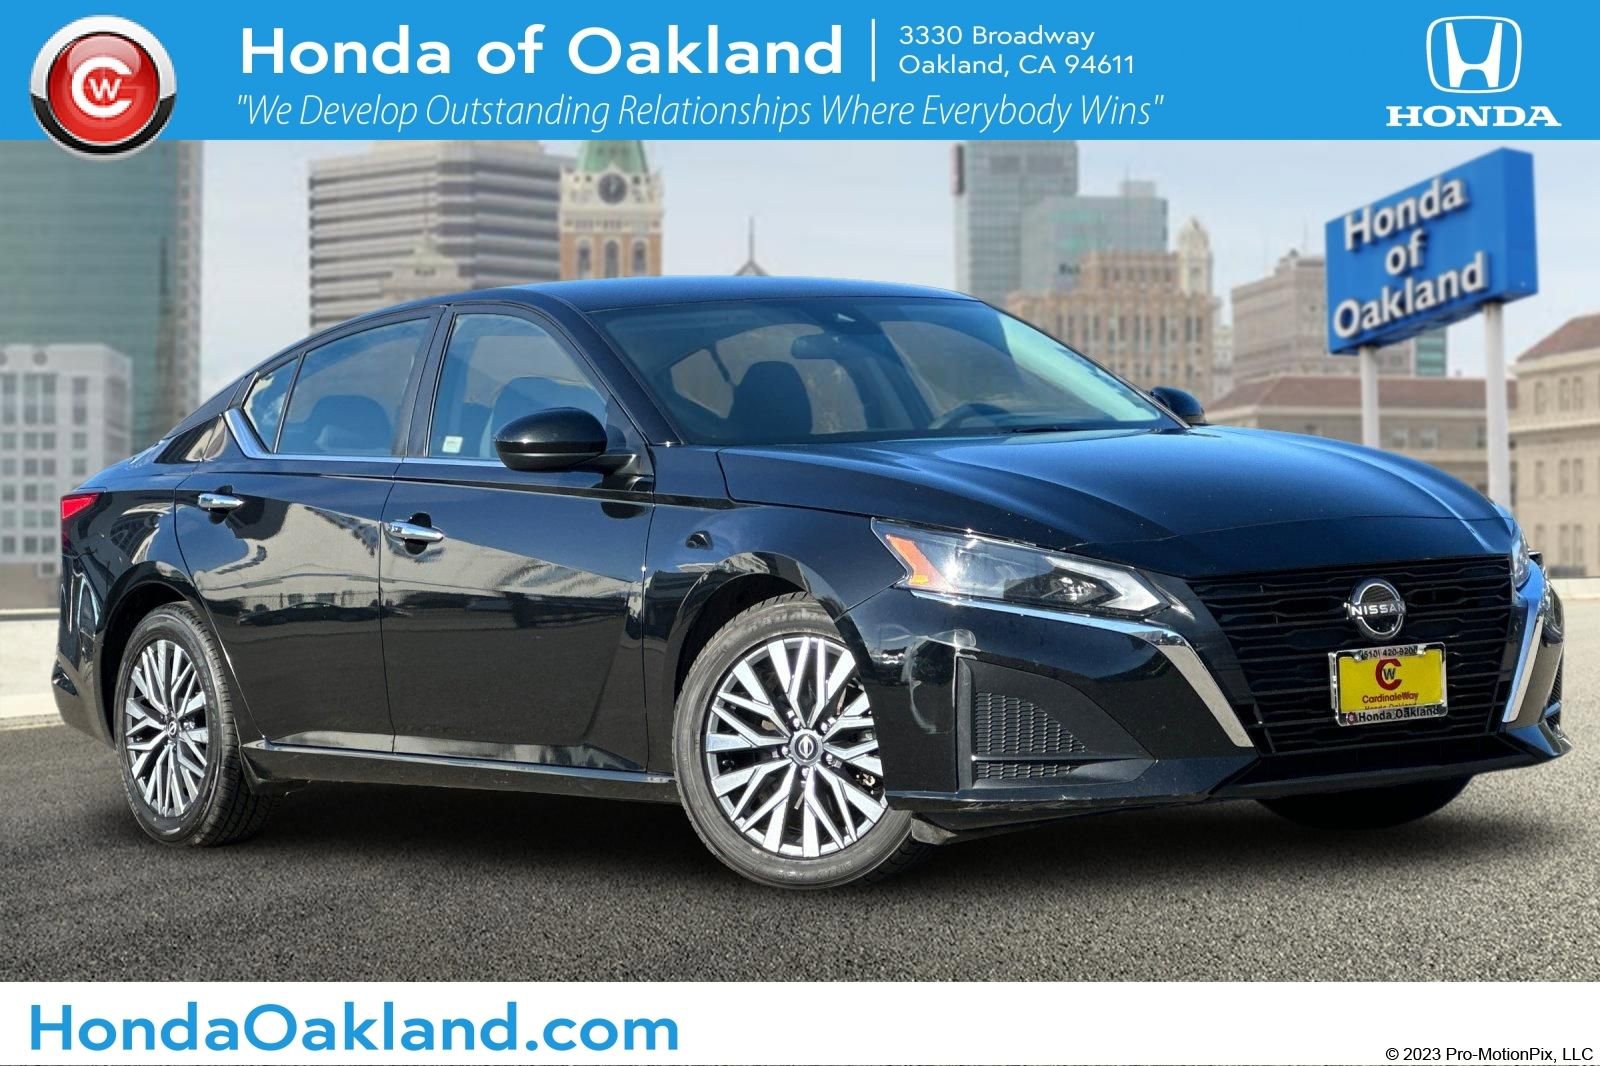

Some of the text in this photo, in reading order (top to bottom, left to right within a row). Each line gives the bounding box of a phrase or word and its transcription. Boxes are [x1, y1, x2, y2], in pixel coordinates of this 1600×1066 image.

[1344, 177, 1467, 251] Honda
[1385, 230, 1427, 276] of
[1333, 252, 1488, 338] Oakland
[1351, 603, 1405, 616] NISSAN
[1358, 711, 1392, 722] Honda
[1395, 707, 1438, 719] Oakland
